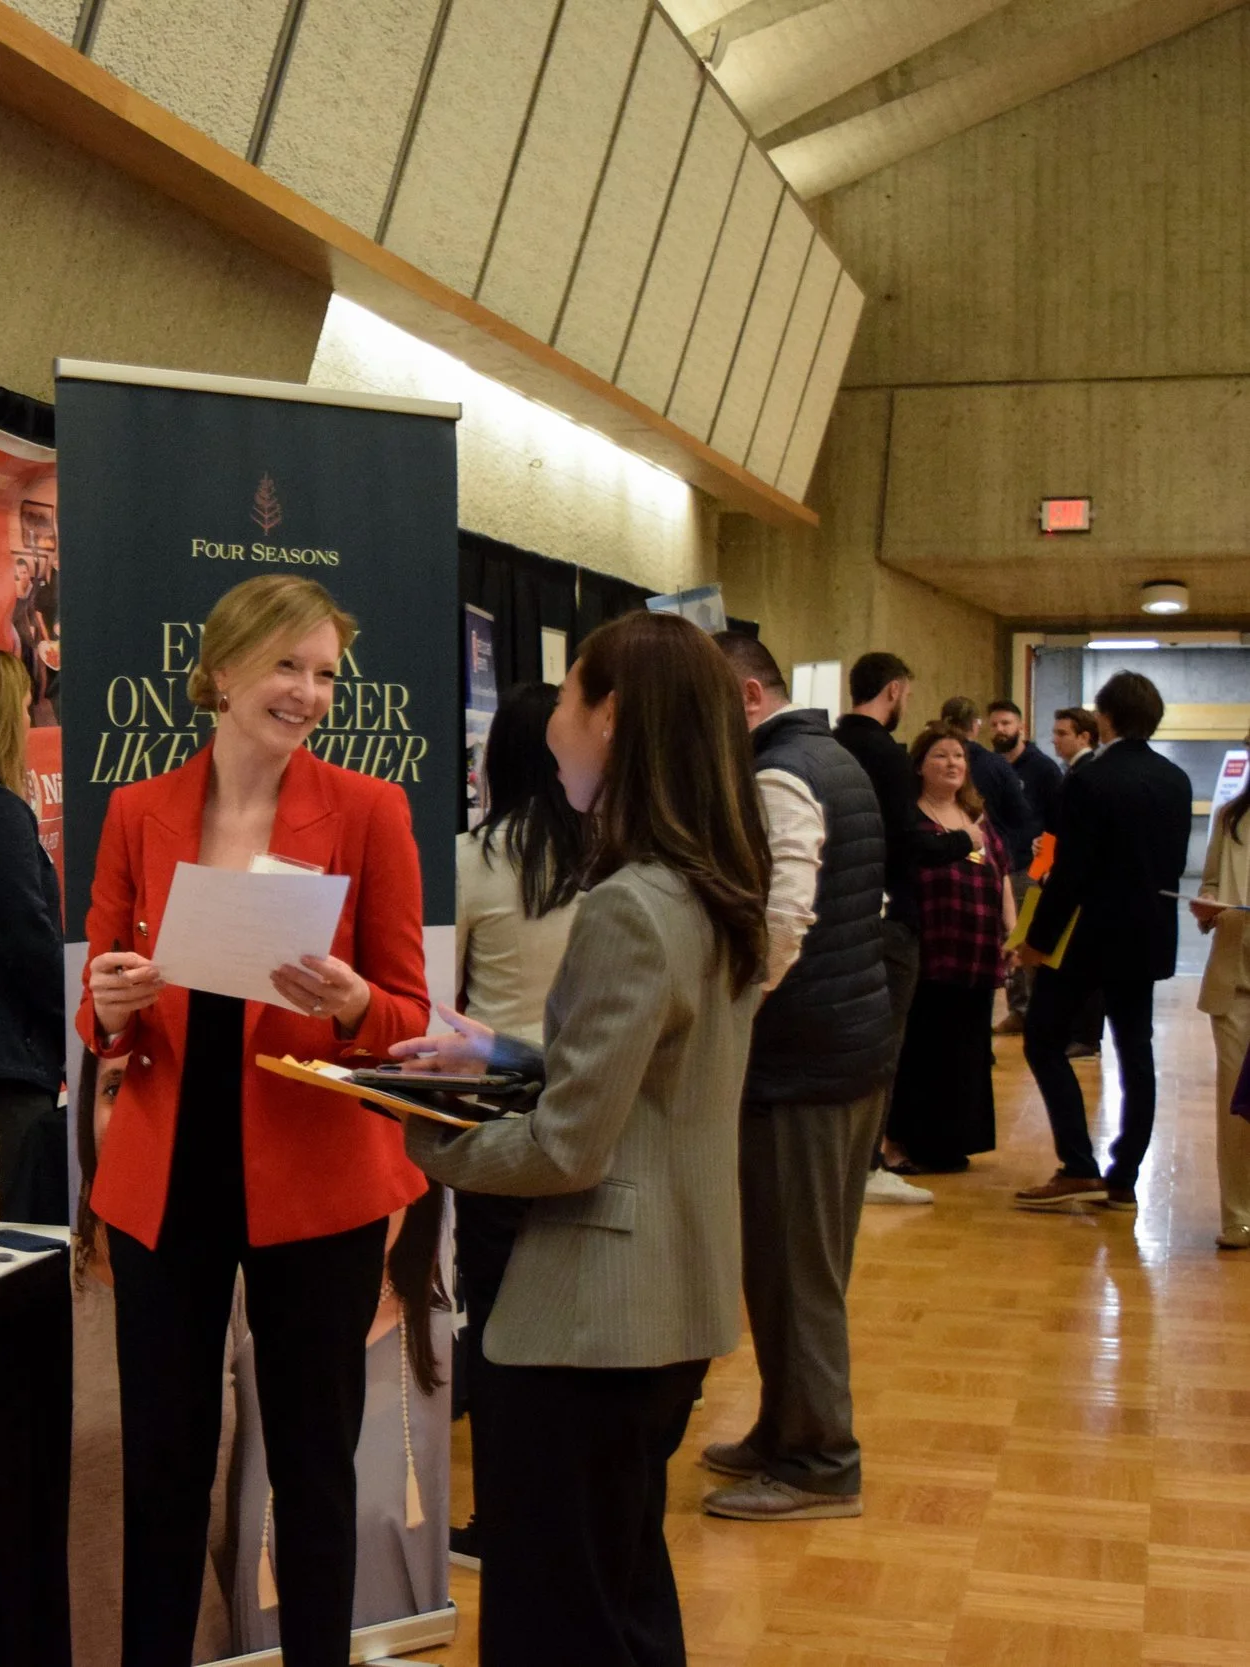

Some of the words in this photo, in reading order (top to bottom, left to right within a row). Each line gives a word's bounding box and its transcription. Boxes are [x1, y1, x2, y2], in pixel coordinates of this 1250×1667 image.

[191, 538, 245, 561] FOUR
[250, 542, 340, 567] SEASONS
[106, 675, 178, 728] ON
[89, 732, 199, 784] LIKE
[306, 733, 429, 784] THER
